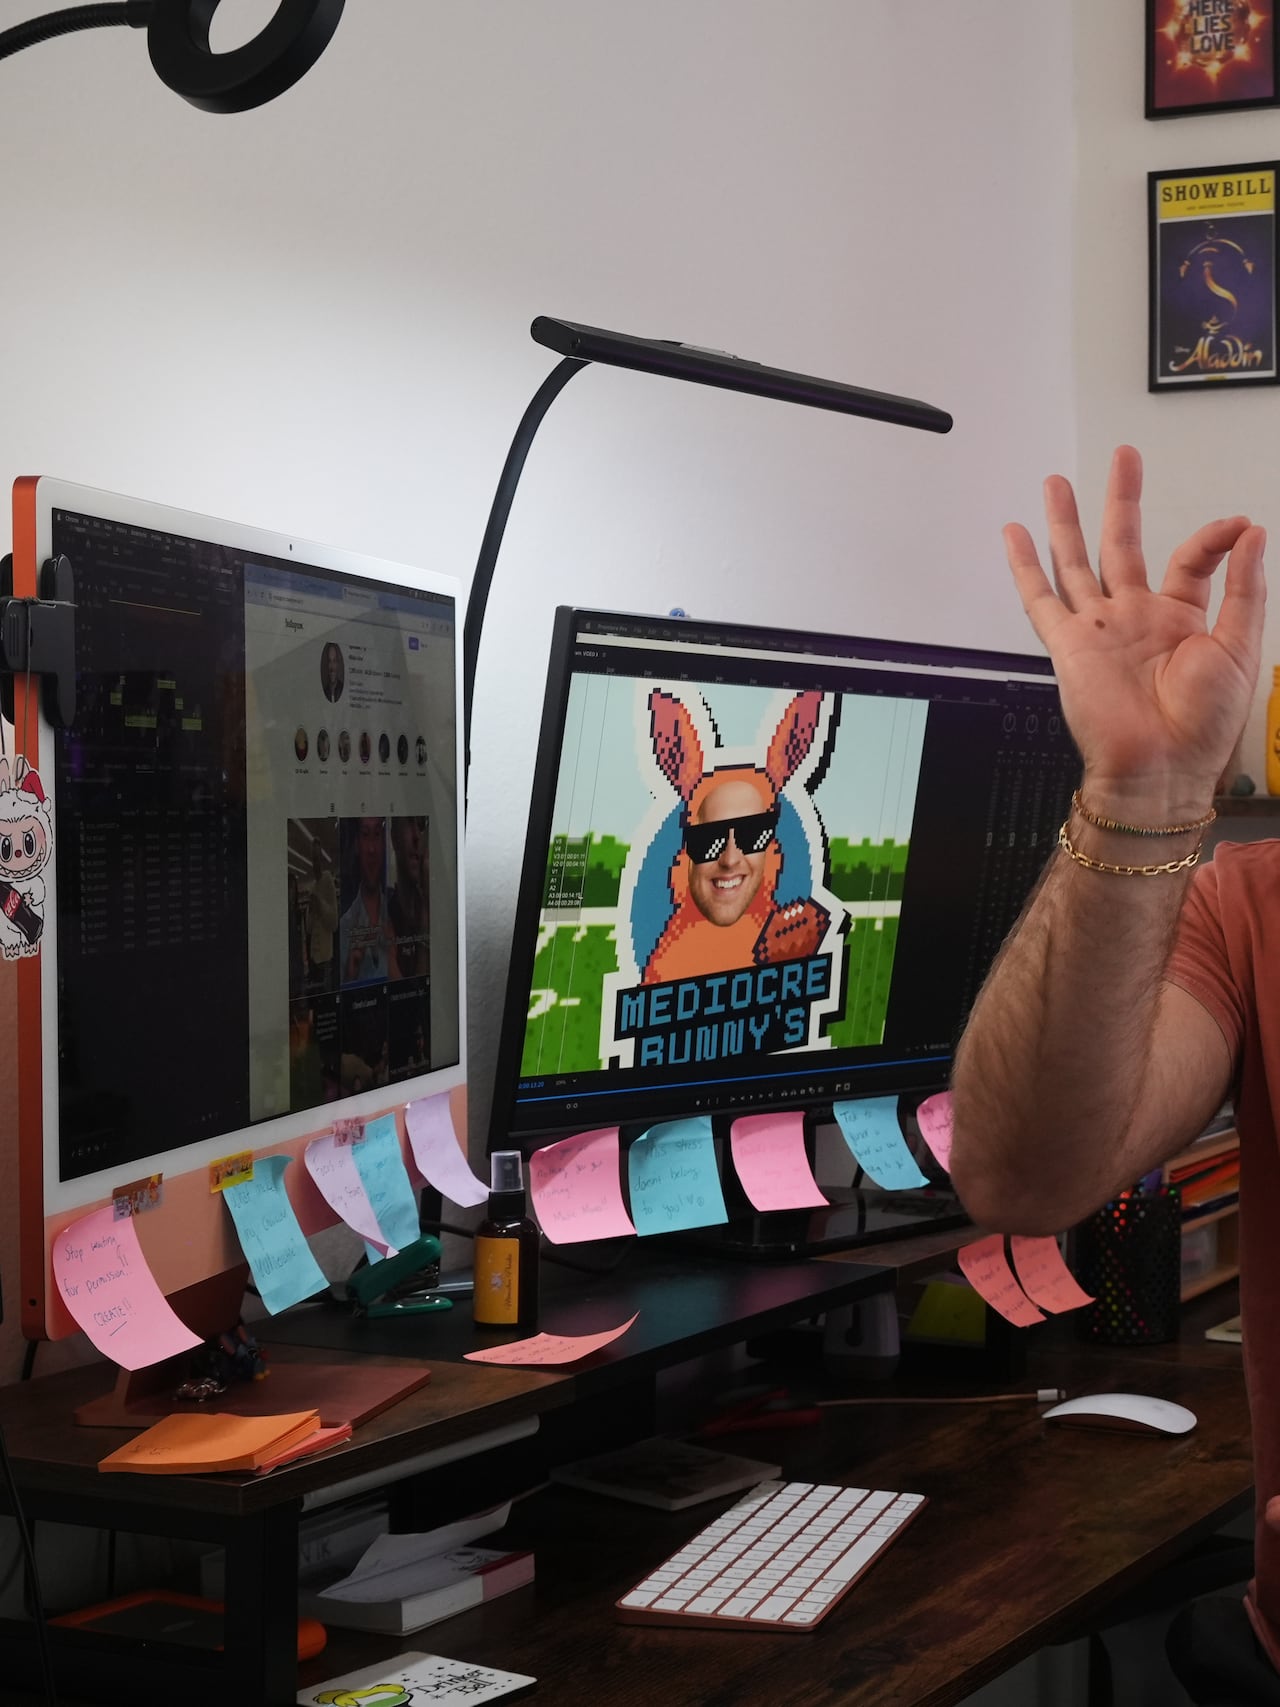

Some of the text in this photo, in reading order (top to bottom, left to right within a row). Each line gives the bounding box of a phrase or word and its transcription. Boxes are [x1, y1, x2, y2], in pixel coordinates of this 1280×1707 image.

[1189, 0, 1234, 17] HERE
[1194, 14, 1232, 35] LIES
[1190, 33, 1235, 54] LOVE
[1161, 178, 1271, 203] SHOWBILL
[1168, 335, 1263, 372] Aladdin
[620, 958, 828, 1032] MEDIOCRE
[65, 1244, 84, 1263] Stop
[413, 1668, 484, 1695] Drinker
